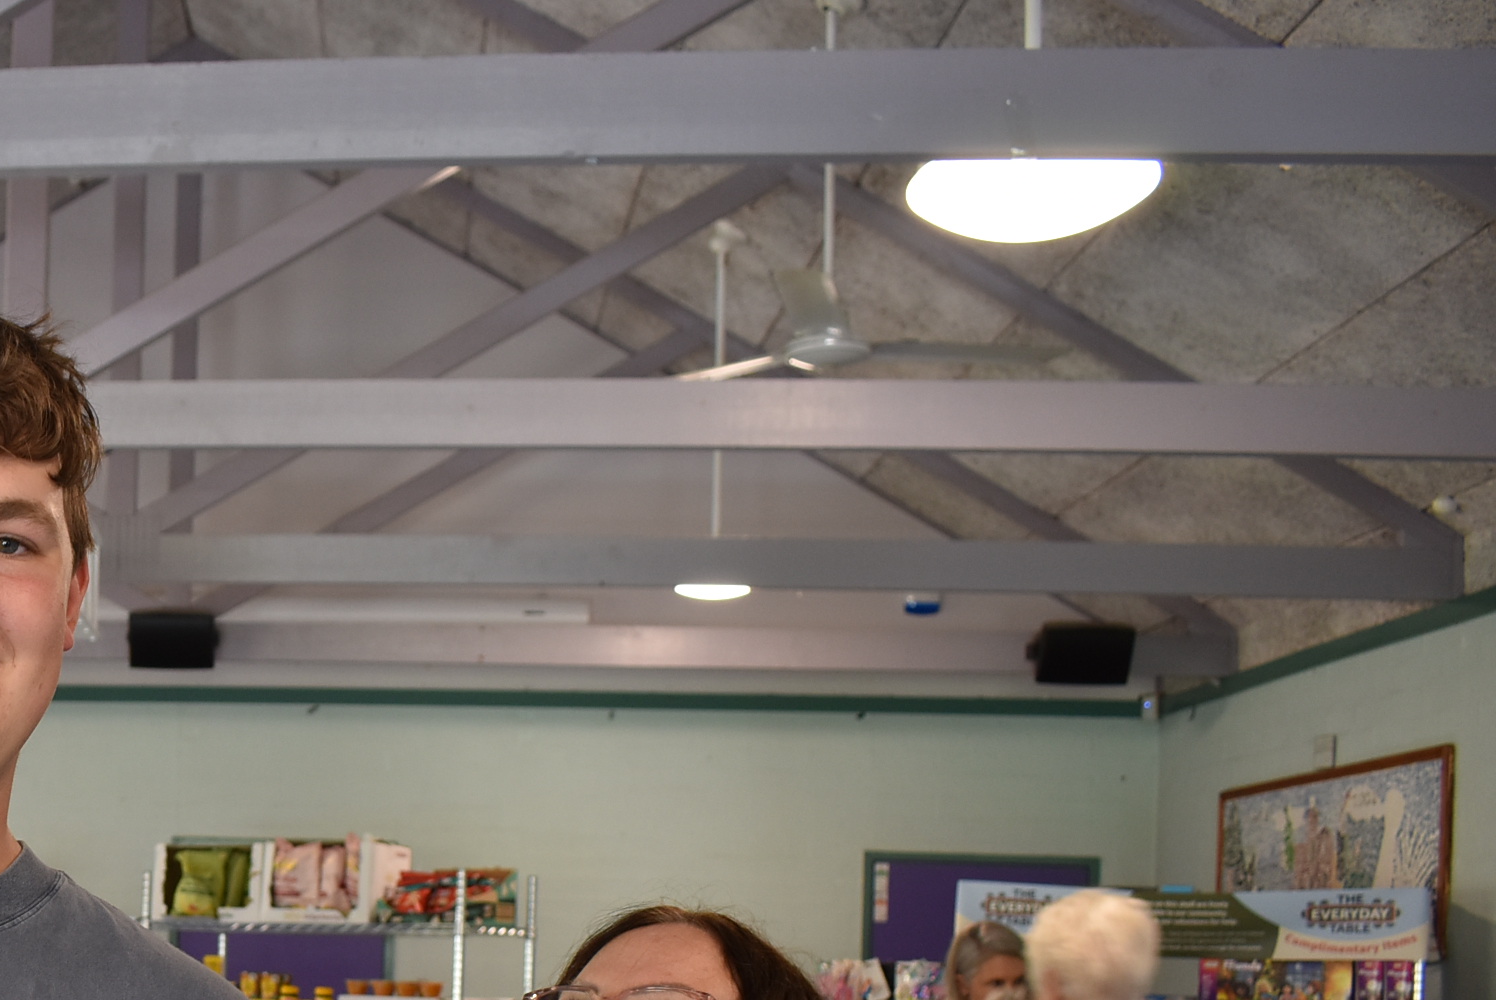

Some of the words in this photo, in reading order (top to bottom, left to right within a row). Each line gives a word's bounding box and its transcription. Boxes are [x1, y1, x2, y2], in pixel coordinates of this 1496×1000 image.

[1338, 893, 1364, 904] THE
[1310, 907, 1390, 921] EVERYDAY
[1331, 923, 1370, 934] TABLE
[1383, 935, 1418, 950] Items
